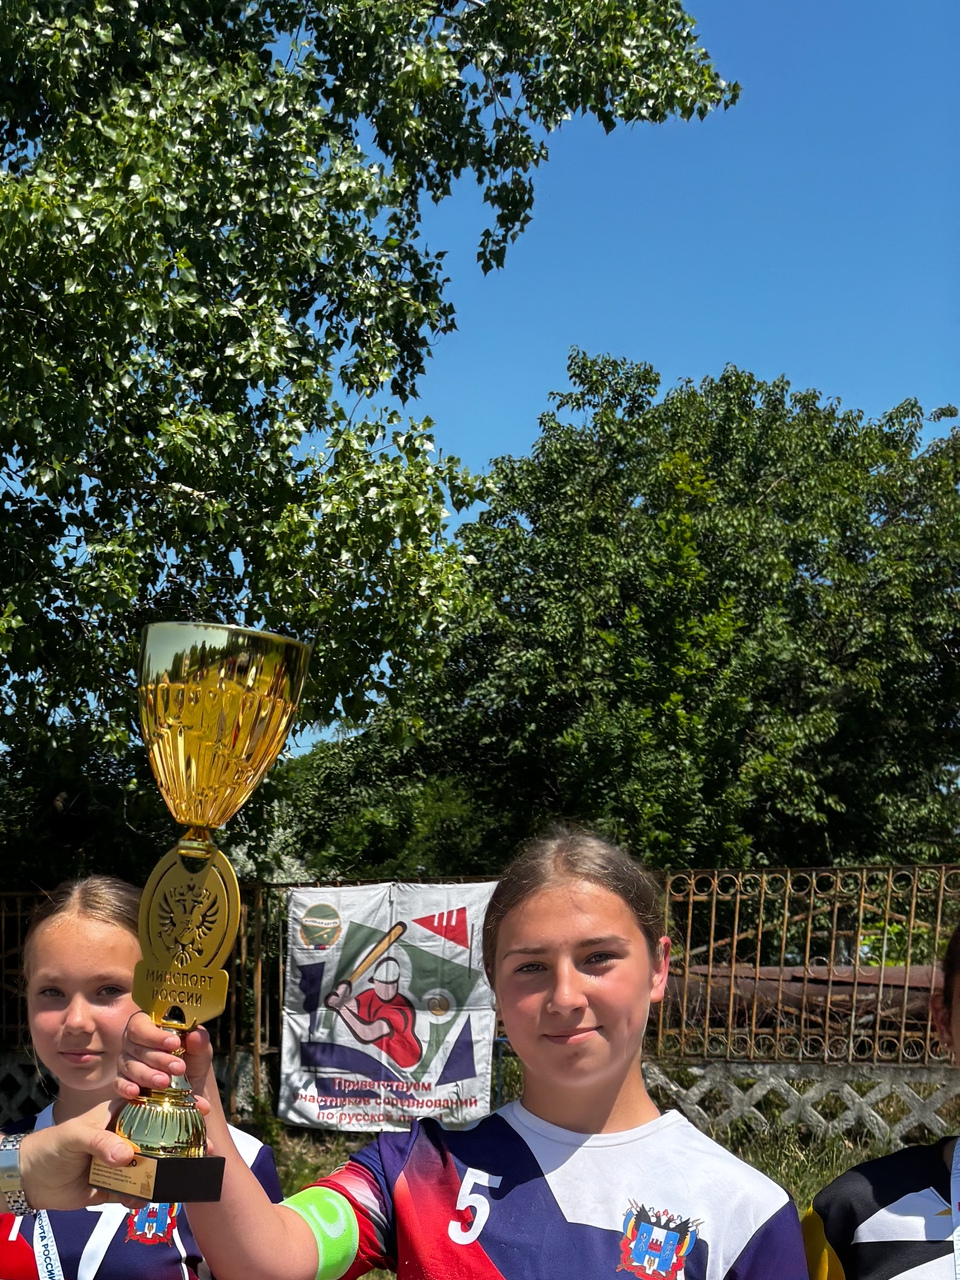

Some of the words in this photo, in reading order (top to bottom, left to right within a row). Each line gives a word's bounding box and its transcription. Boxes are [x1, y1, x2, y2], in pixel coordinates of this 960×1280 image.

[146, 969, 213, 990] МИНСПОРТ
[151, 988, 202, 1006] РОССИИ
[334, 1077, 431, 1095] Приветствуем
[375, 1095, 478, 1109] соревнований
[317, 1111, 334, 1120] по
[448, 1167, 503, 1245] 5
[37, 1212, 47, 1242] ПОРТА
